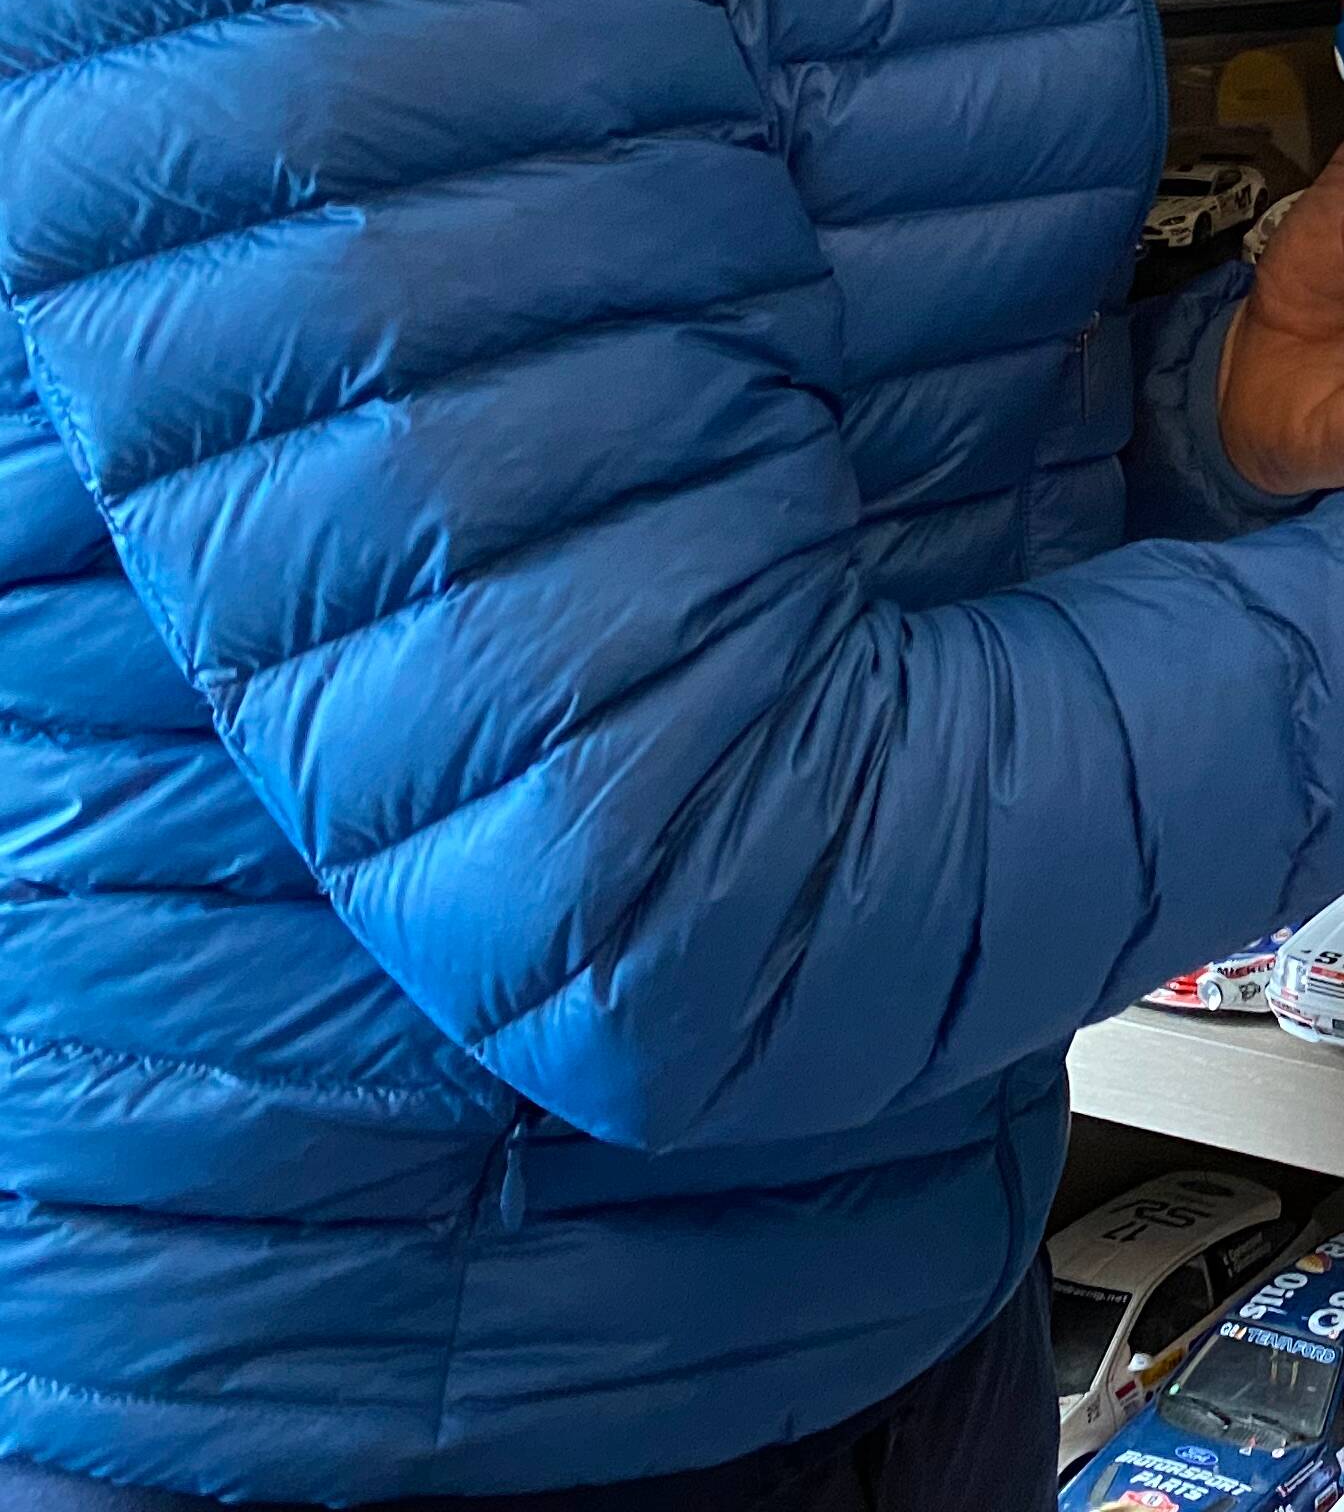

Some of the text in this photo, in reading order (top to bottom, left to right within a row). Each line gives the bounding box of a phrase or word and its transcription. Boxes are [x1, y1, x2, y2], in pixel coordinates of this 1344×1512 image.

[1292, 1338, 1337, 1365] FORD
[1115, 1449, 1253, 1497] MOTORSPORT
[1129, 1471, 1209, 1502] PARTS
